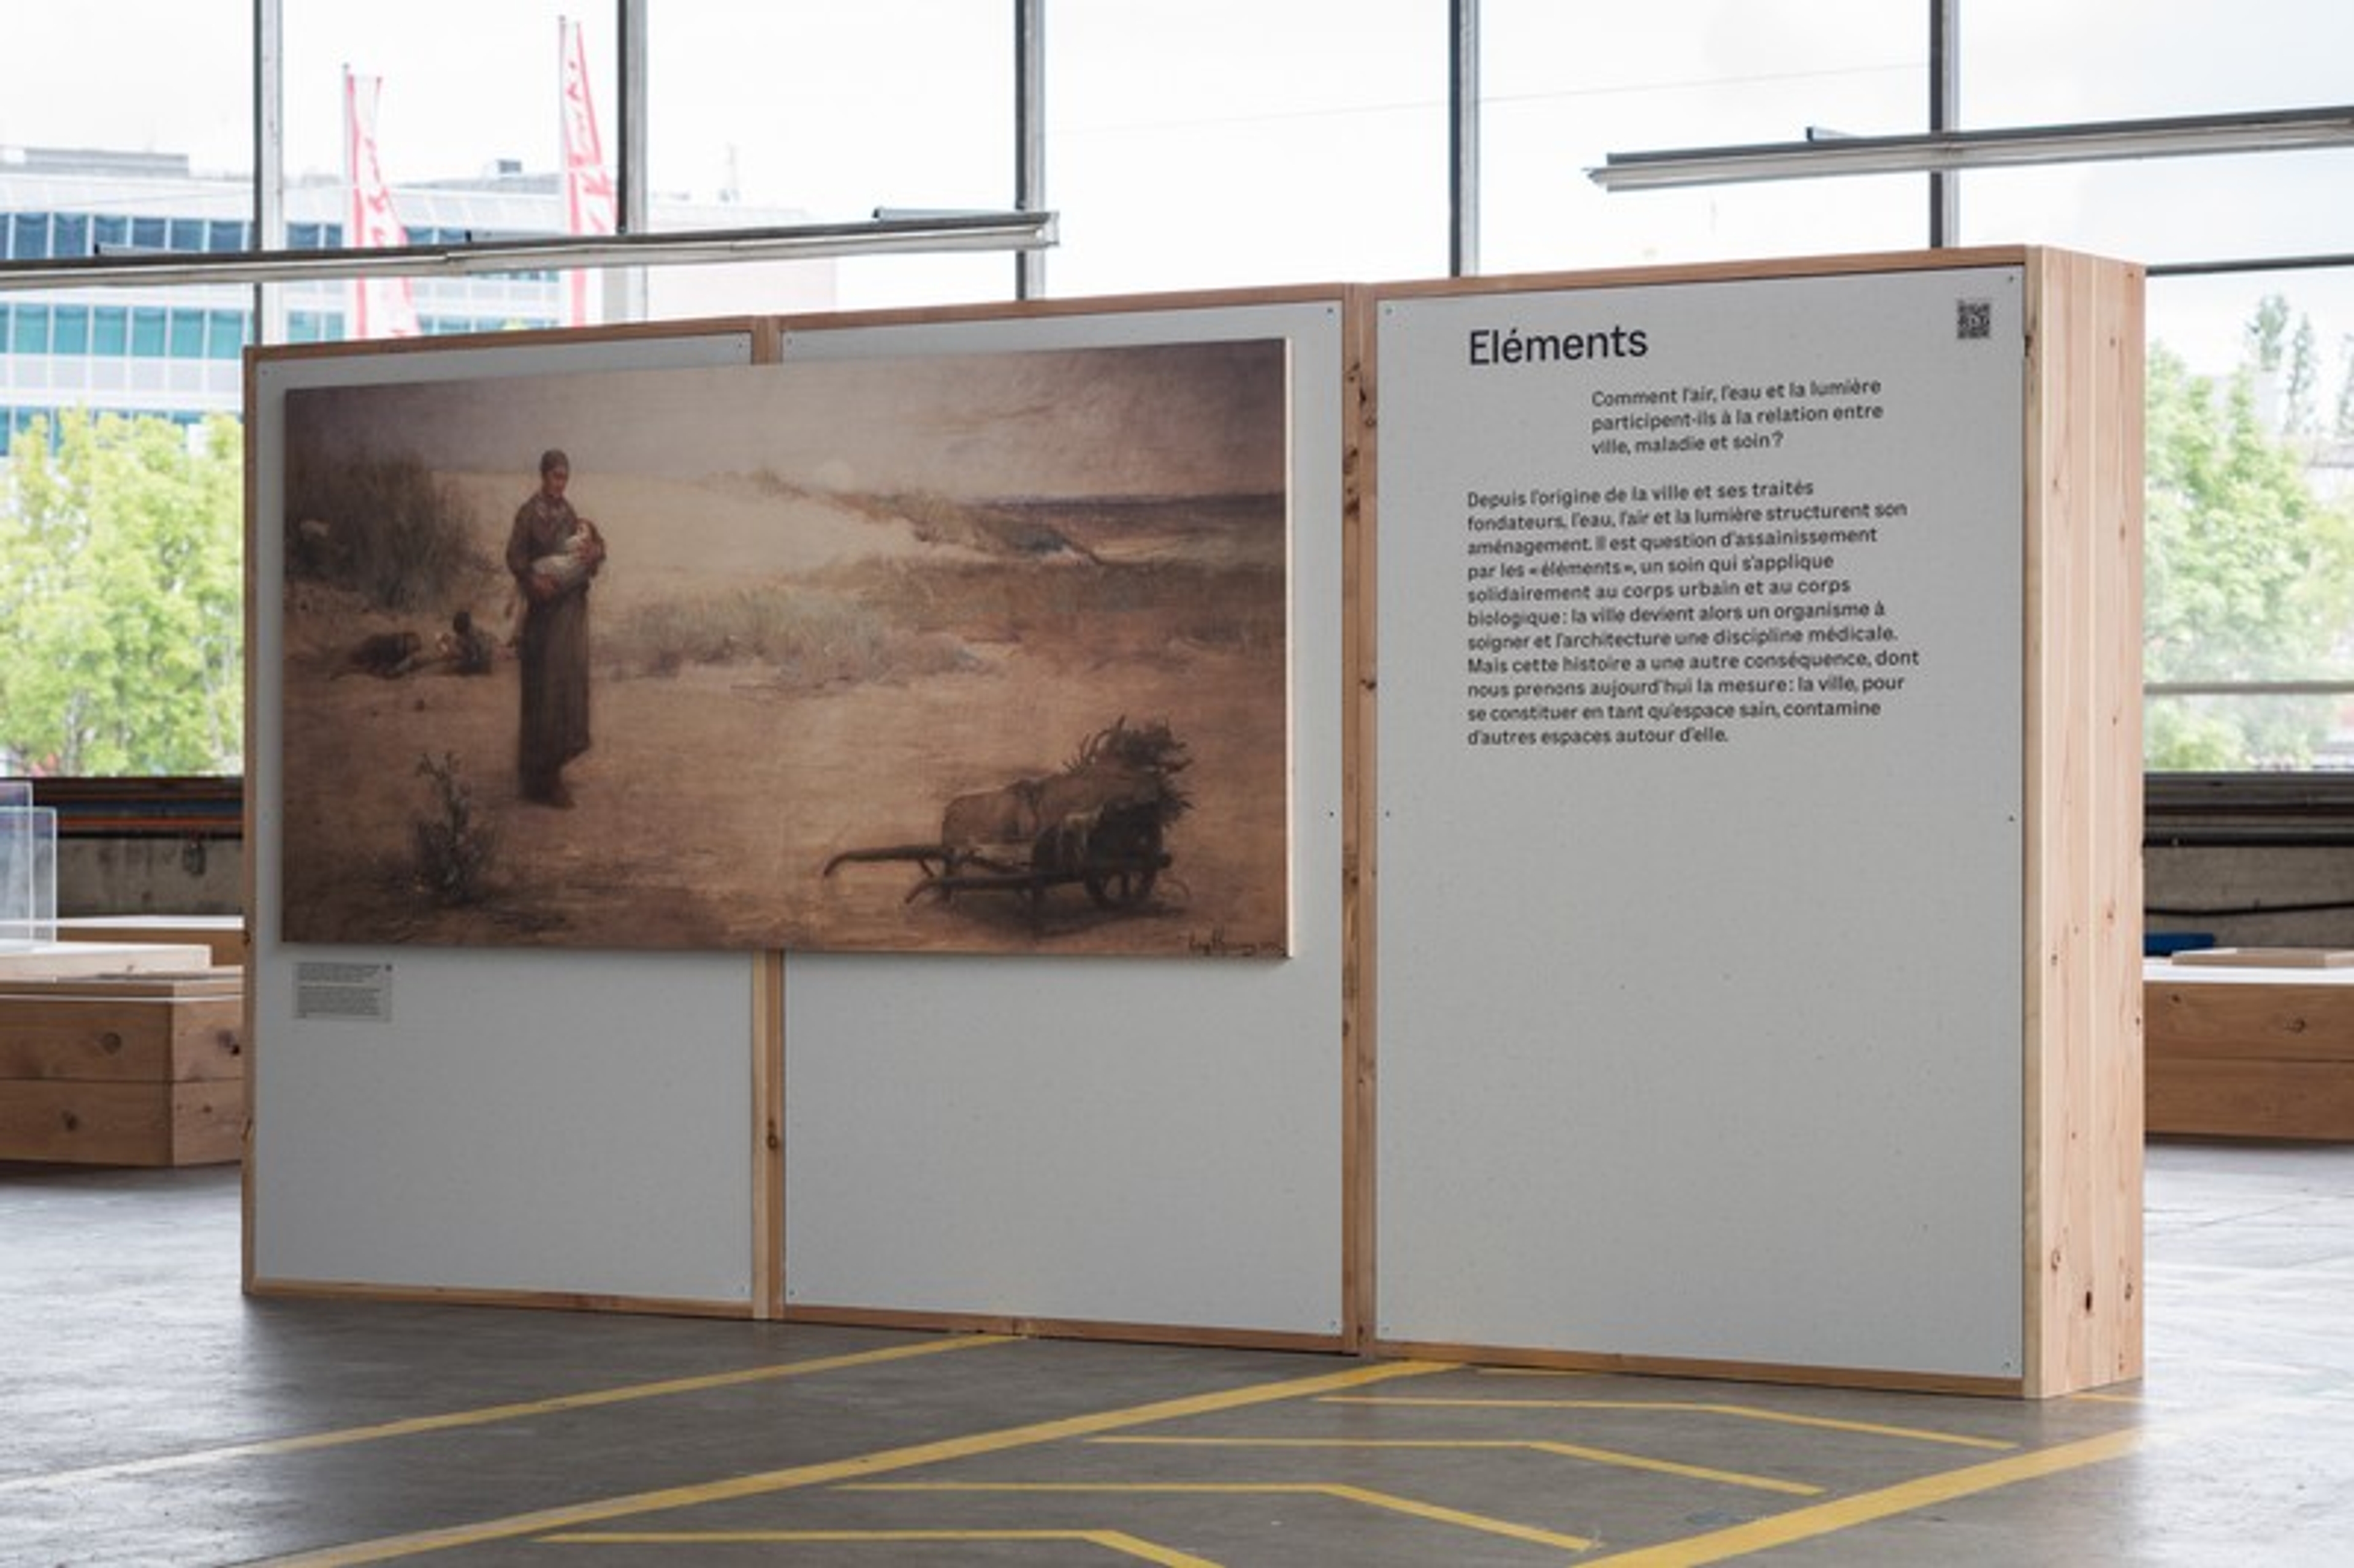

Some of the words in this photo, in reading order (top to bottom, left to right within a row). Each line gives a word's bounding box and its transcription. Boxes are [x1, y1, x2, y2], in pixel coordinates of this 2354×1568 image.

[1469, 325, 1649, 366] Eléments
[1592, 389, 1678, 407] Comment
[1683, 386, 1718, 403] l'air,
[1721, 385, 1762, 401] l'eau
[1766, 385, 1785, 399] et
[1789, 382, 1806, 397] la
[1810, 378, 1881, 397] lumière
[1593, 411, 1716, 435] participent-ils
[1722, 410, 1731, 425] à
[1737, 409, 1753, 424] la
[1758, 406, 1829, 424] relation
[1833, 405, 1884, 421] entre
[1592, 440, 1631, 455] ville,
[1635, 436, 1706, 454] maladie
[1710, 436, 1728, 451] et
[1468, 490, 1527, 509] Depuis
[1531, 489, 1601, 509] l'origine
[1605, 487, 1628, 503] de
[1632, 487, 1648, 501] la
[1651, 485, 1689, 501] ville
[1693, 485, 1712, 500] et
[1717, 486, 1748, 499] ses
[1752, 480, 1814, 498] traités
[1468, 516, 1567, 533] fondateurs,
[1572, 513, 1616, 528] l'eau,
[1620, 511, 1649, 526] l'air
[1654, 511, 1671, 525] et
[1676, 510, 1691, 524] la
[1696, 507, 1762, 524] lumière
[1767, 504, 1870, 521] structurent
[1875, 504, 1908, 518] son
[1468, 539, 1592, 557] aménagement.
[1610, 536, 1636, 551] est
[1640, 534, 1716, 553] question
[1721, 528, 1878, 547] d'assainissement
[1468, 567, 1496, 582] par
[1501, 563, 1524, 577] les
[1641, 562, 1663, 574] un
[1669, 557, 1704, 573] soin
[1710, 555, 1737, 574] qui
[1743, 554, 1834, 574] s'applique
[1468, 587, 1590, 603] solidairement
[1596, 587, 1618, 600] au
[1623, 586, 1674, 601] corps
[1680, 580, 1740, 597] urbain
[1745, 580, 1764, 595] et
[1769, 583, 1792, 595] au
[1798, 580, 1851, 595] corps
[1572, 609, 1586, 624] la
[1591, 608, 1625, 623] ville
[1631, 607, 1694, 622] devient
[1700, 606, 1743, 621] alors
[1748, 607, 1770, 620] un
[1775, 602, 1870, 622] organisme
[1875, 601, 1886, 617] à
[1468, 635, 1530, 653] soigner
[1534, 635, 1552, 649] et
[1556, 633, 1671, 648] l'architecture
[1675, 633, 1709, 645] une
[1713, 628, 1803, 647] discipline
[1809, 625, 1898, 642] médicale.
[1468, 658, 1508, 674] Mais
[1513, 659, 1558, 674] cette
[1563, 657, 1631, 672] histoire
[1637, 659, 1646, 671] a
[1651, 658, 1684, 671] une
[1690, 656, 1739, 669] autre
[1745, 652, 1872, 670] conséquence,
[1875, 650, 1919, 666] dont
[1468, 685, 1509, 698] nous
[1514, 684, 1585, 699] prenons
[1591, 678, 1692, 698] aujourd'hui
[1697, 678, 1713, 694] la
[1799, 677, 1813, 692] la
[1819, 676, 1859, 693] ville,
[1863, 678, 1905, 695] pour
[1468, 709, 1487, 721] se
[1490, 707, 1578, 721] constituer
[1583, 707, 1604, 720] en
[1608, 706, 1644, 719] tant
[1648, 704, 1735, 721] qu'espace
[1740, 701, 1781, 719] sain,
[1783, 701, 1881, 717] contamine
[1468, 730, 1537, 745] d'autres
[1541, 731, 1612, 747] espaces
[1616, 729, 1675, 744] autour
[1680, 727, 1729, 743] d'elle.
